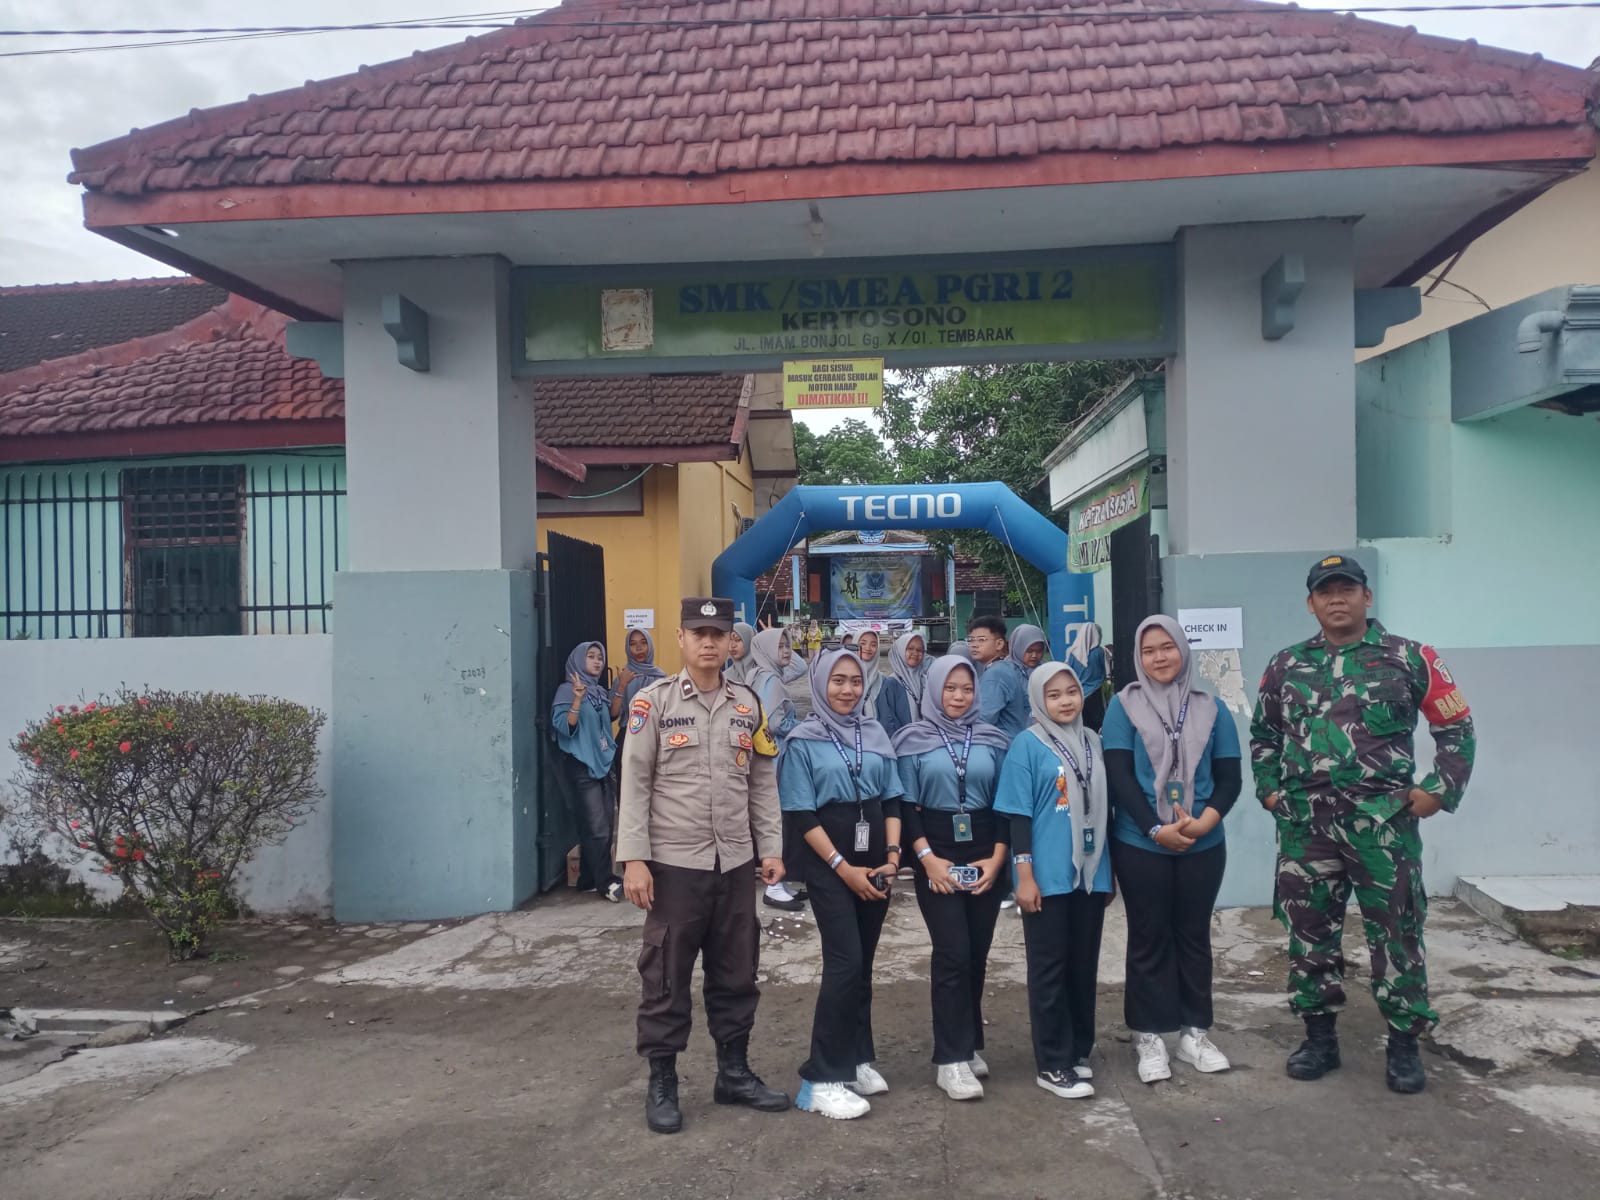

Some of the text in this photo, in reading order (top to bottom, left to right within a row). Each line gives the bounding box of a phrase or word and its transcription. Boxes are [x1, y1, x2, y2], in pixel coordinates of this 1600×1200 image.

[936, 271, 1042, 304] PGRI
[1052, 270, 1073, 300] 2
[782, 306, 967, 331] KERTOSONO
[734, 338, 754, 351] JL.
[760, 336, 795, 350] IMAM
[801, 333, 856, 348] BONJOL
[938, 327, 1015, 343] TEMBARAK
[812, 363, 854, 373] BAGI SISWA
[788, 373, 878, 382] MASUK GERBANG SEKOLAH
[808, 382, 858, 392] MOTOR HARAP
[798, 393, 855, 405] DIMATIKAN
[838, 493, 962, 520] TECNO
[1184, 623, 1227, 633] CHECK IN
